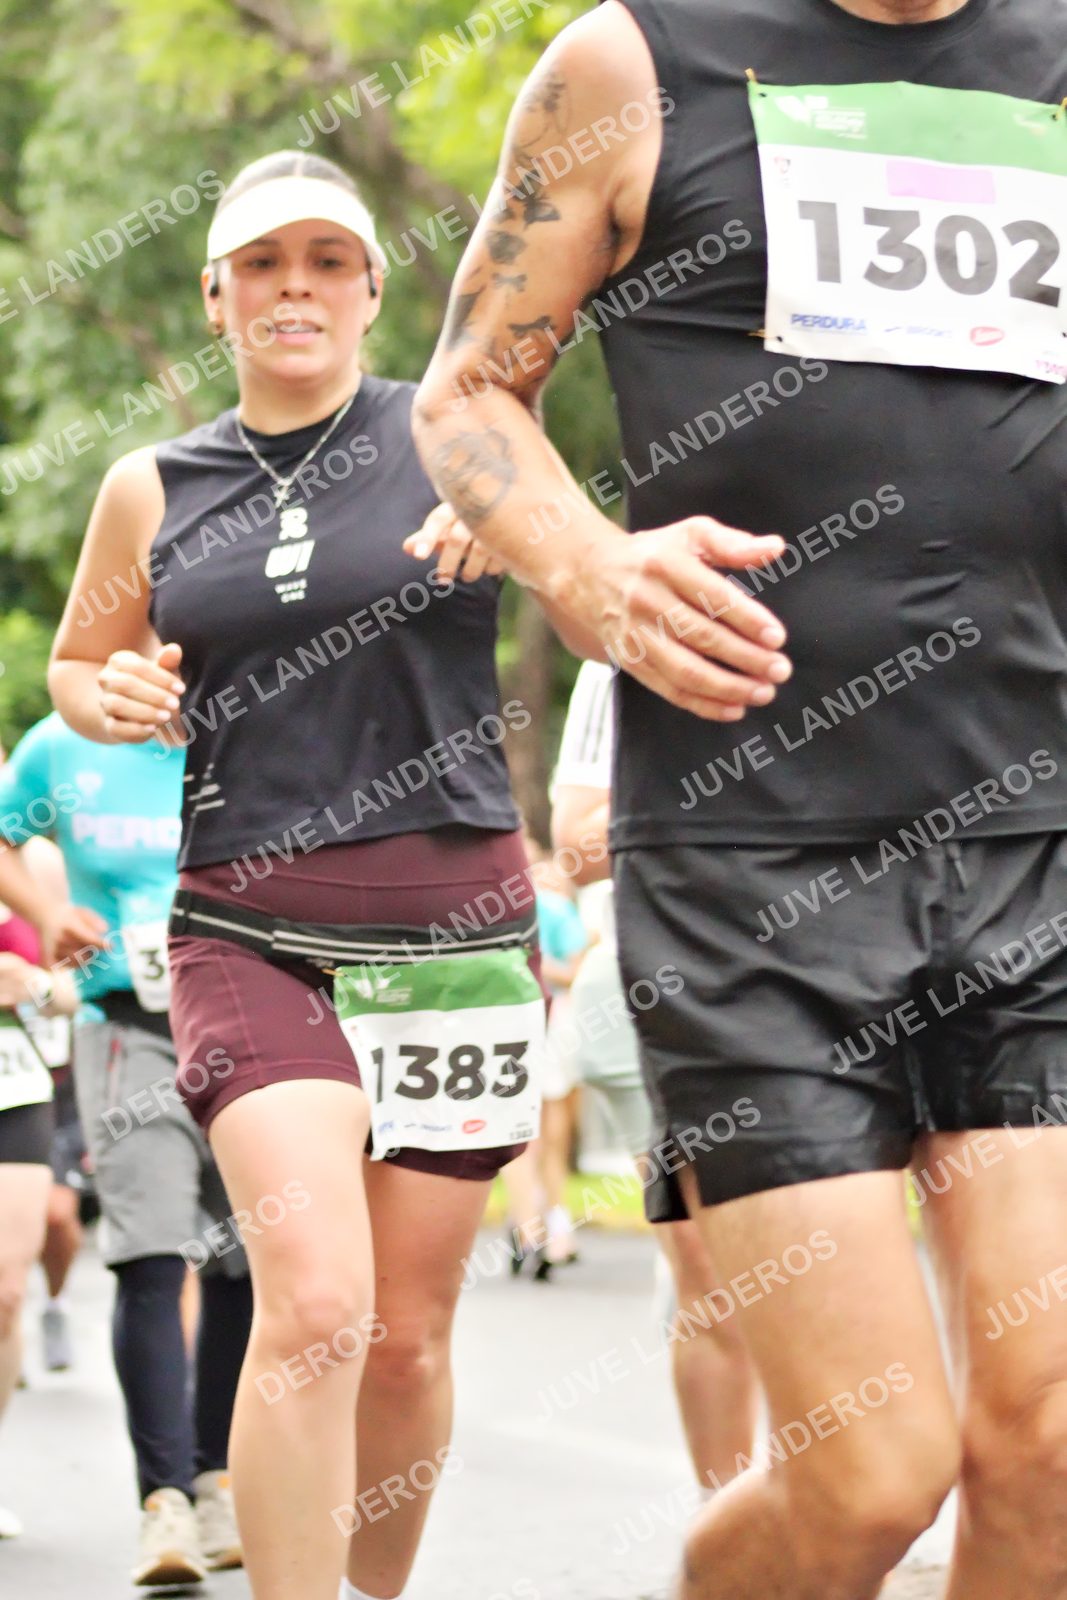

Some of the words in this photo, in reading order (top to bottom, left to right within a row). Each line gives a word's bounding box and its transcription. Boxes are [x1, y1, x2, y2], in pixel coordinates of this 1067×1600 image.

[798, 200, 1061, 307] 1302
[791, 313, 866, 331] PERDURA
[371, 1041, 529, 1104] 1383
